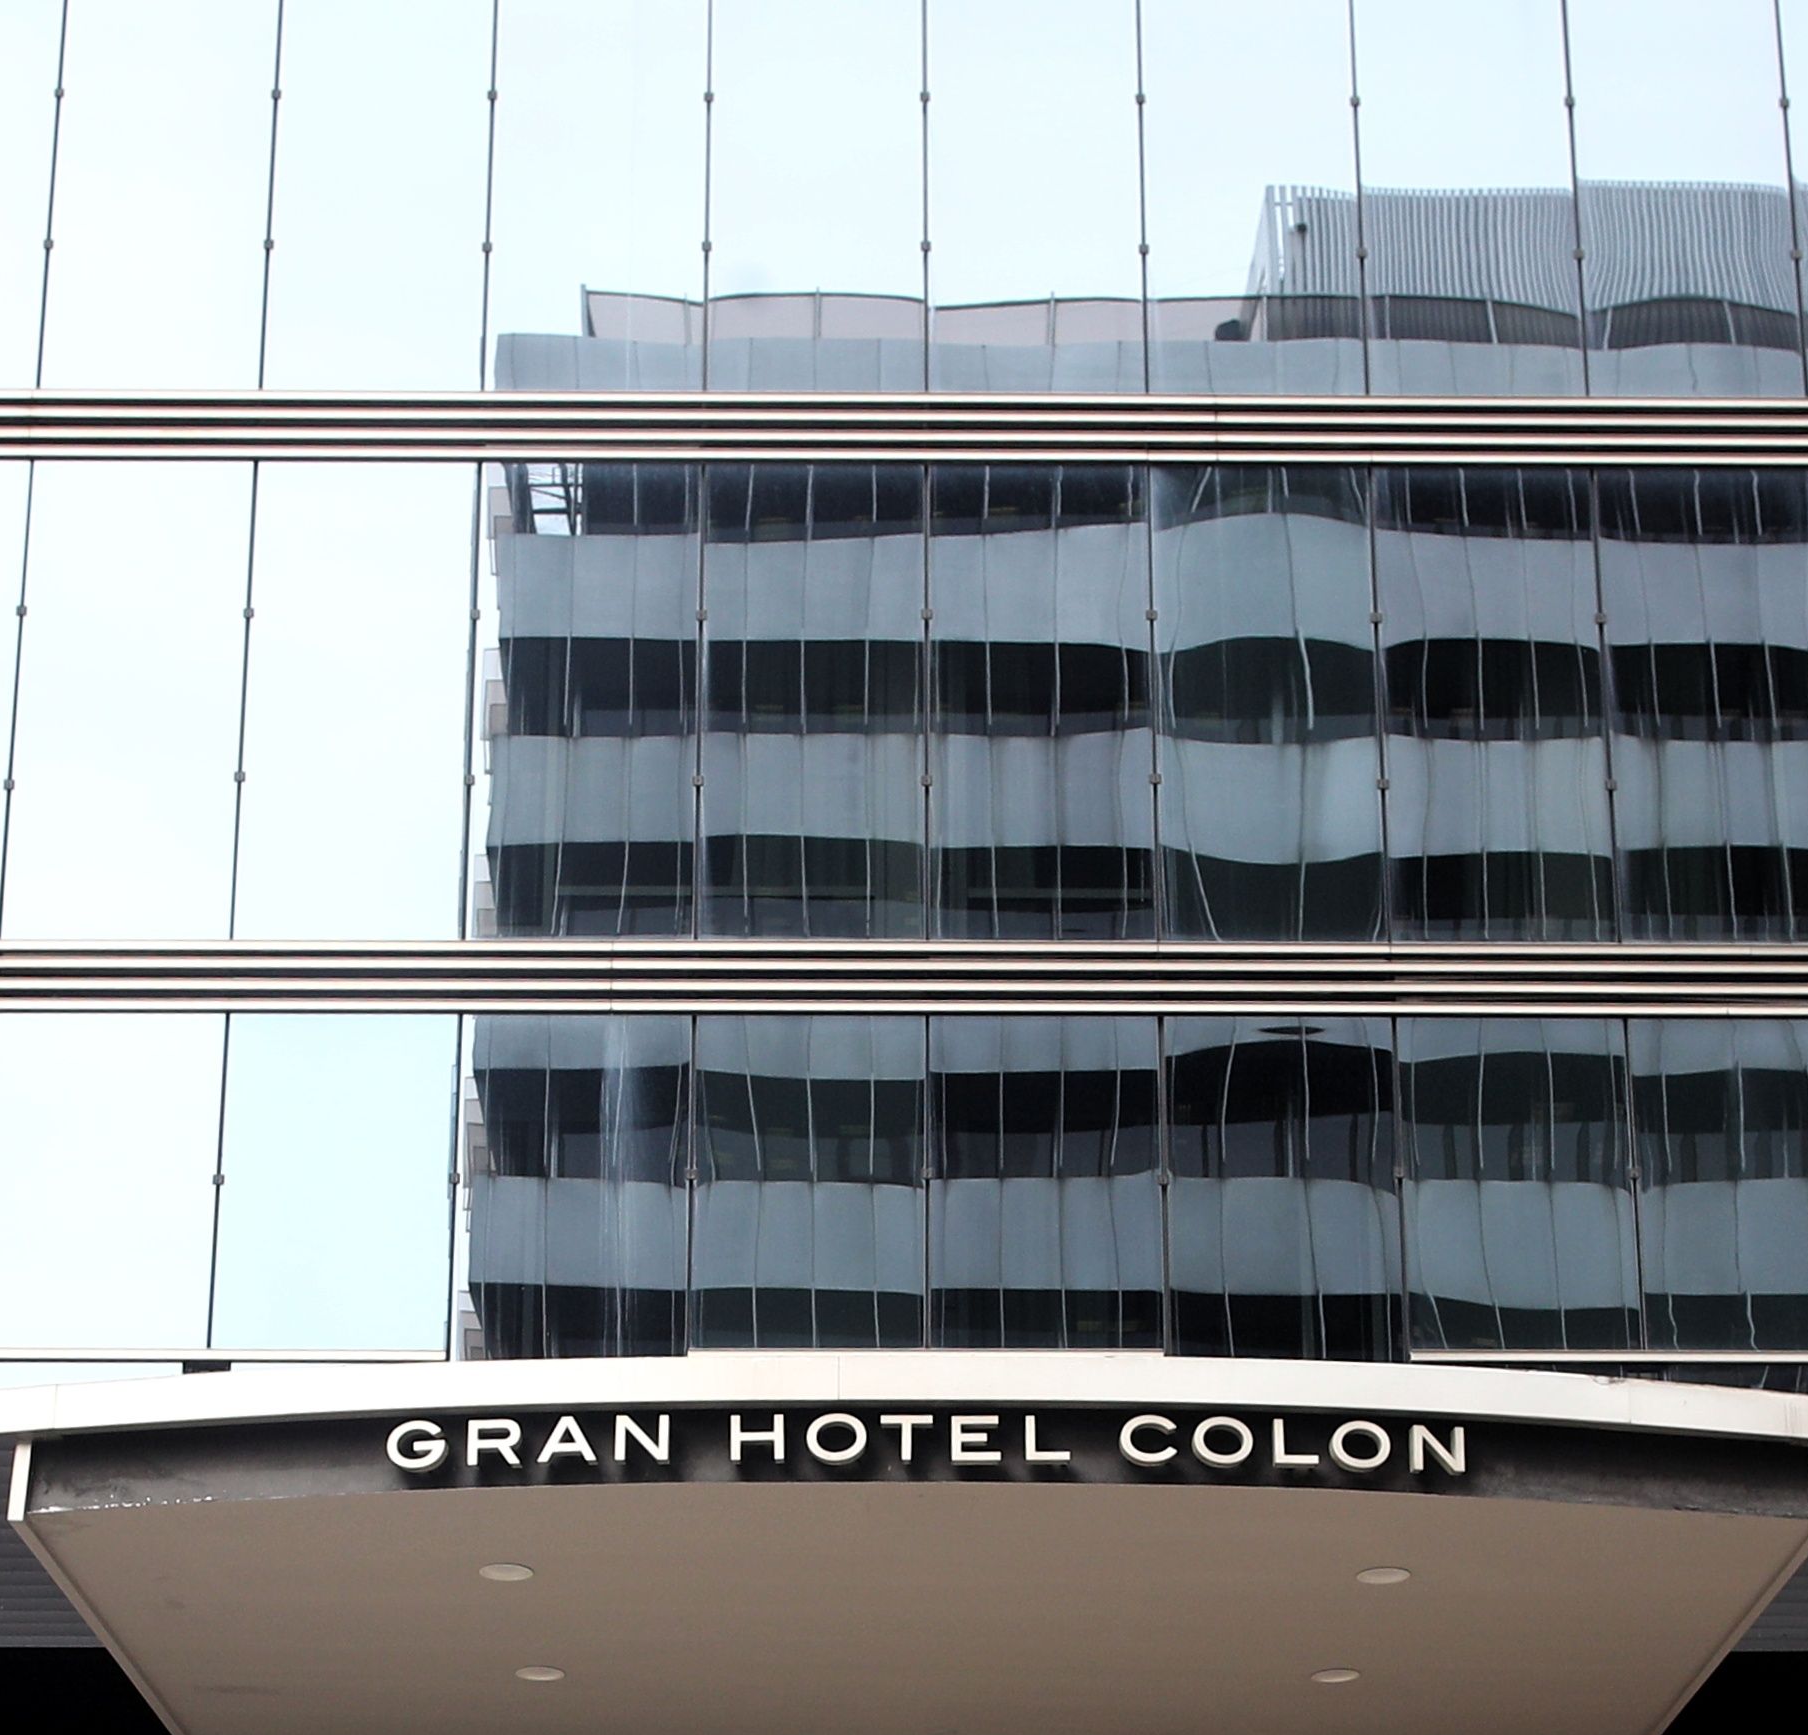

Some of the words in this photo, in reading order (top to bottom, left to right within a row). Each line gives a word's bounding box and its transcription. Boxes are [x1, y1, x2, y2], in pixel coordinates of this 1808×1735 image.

[386, 1413, 671, 1469] GRAN
[729, 1412, 1071, 1463] HOTEL
[1119, 1414, 1467, 1474] COLON
